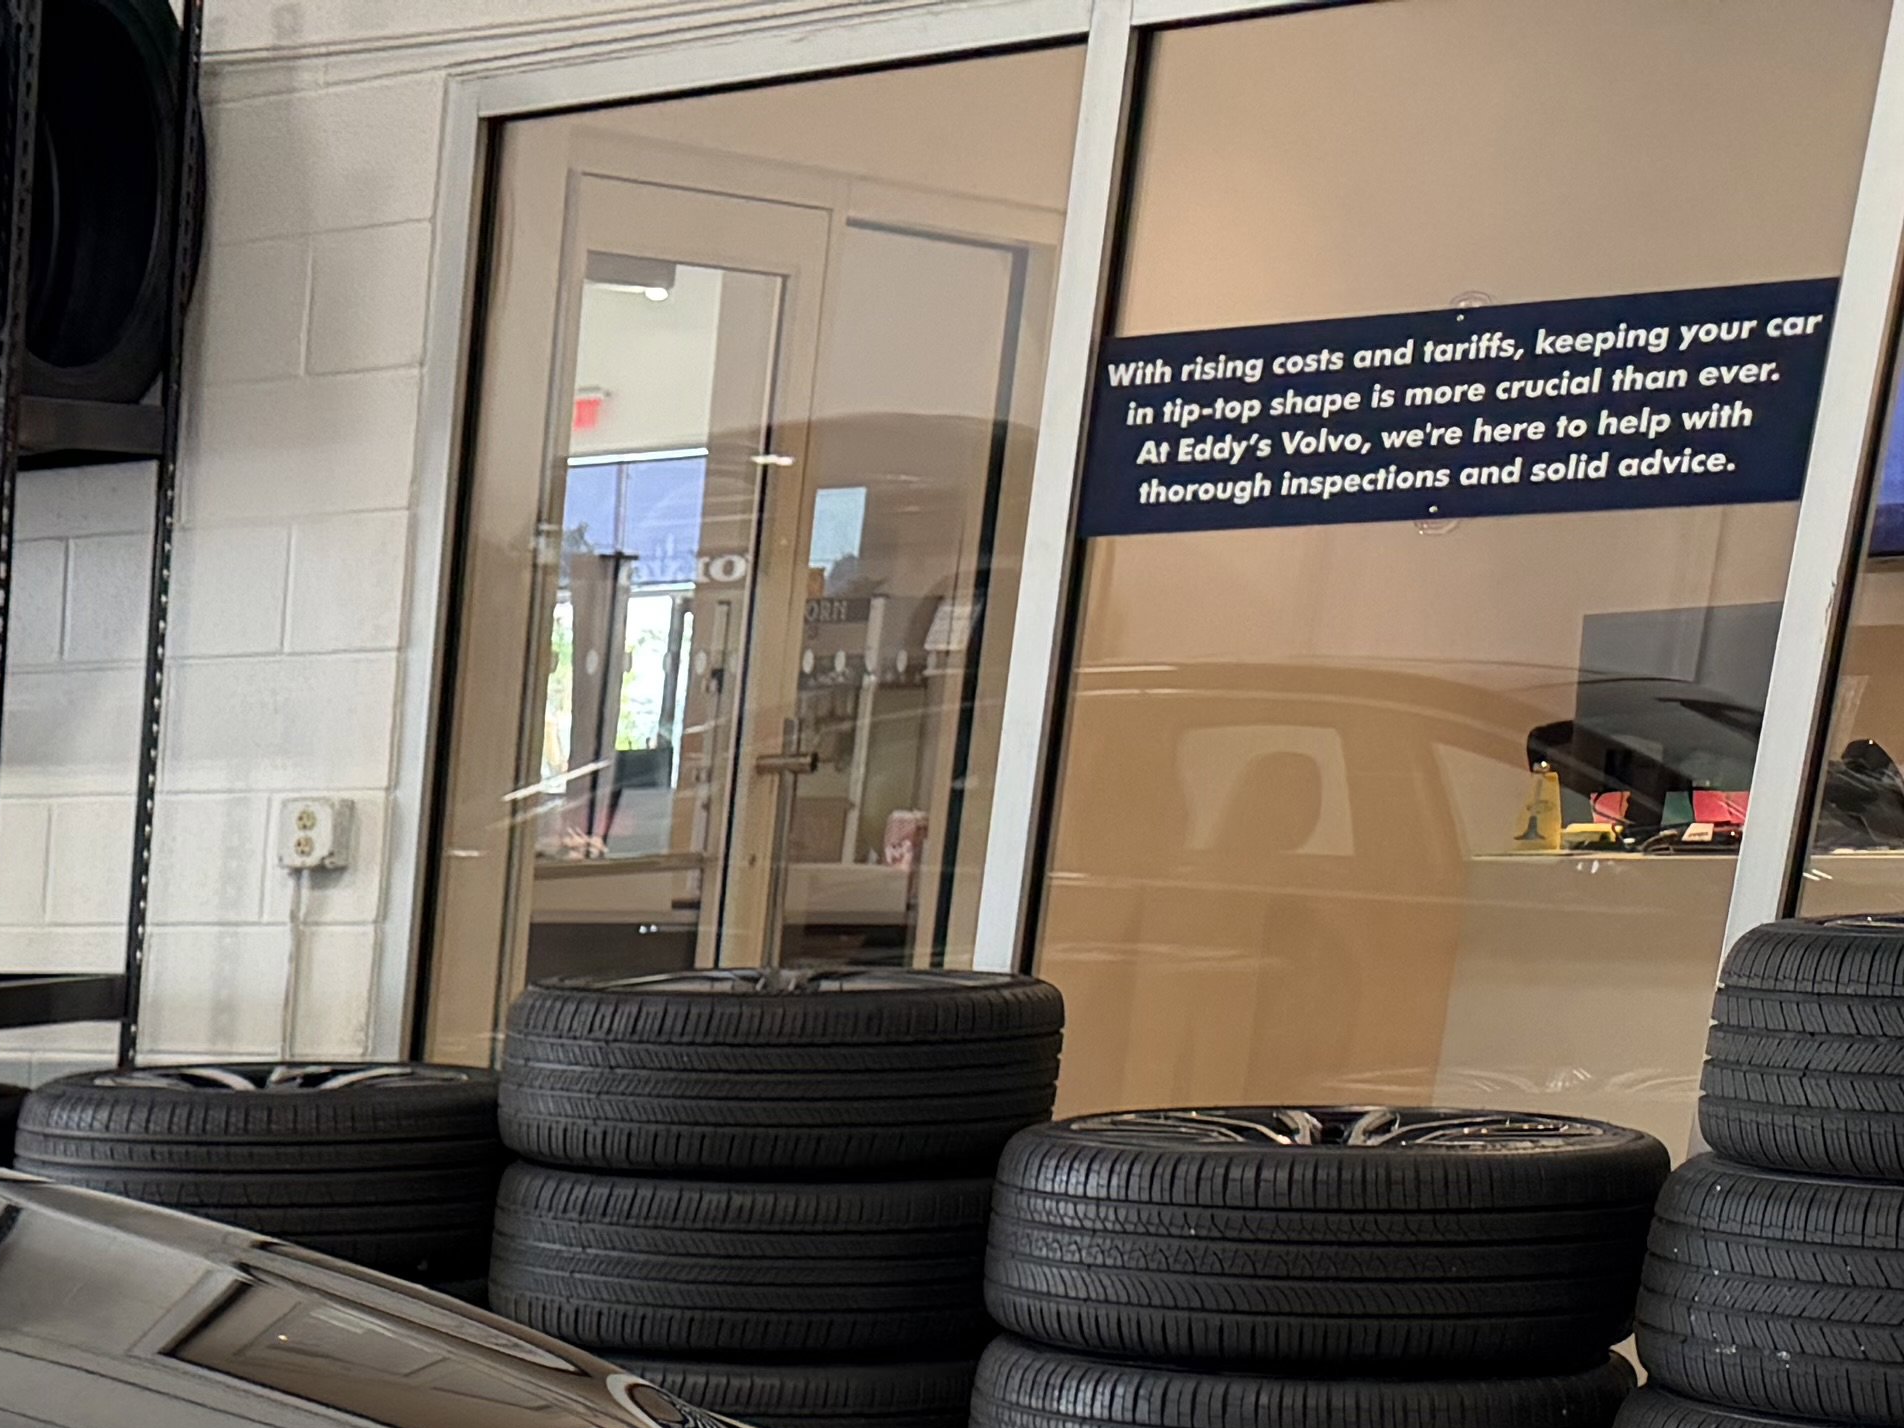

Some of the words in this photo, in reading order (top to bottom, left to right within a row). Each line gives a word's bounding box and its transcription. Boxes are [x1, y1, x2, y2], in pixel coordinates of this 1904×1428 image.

[1107, 358, 1173, 387] With
[1181, 354, 1265, 384] rising
[1272, 349, 1345, 375] costs
[1353, 338, 1415, 369] and
[1423, 331, 1525, 363] tariffs,
[1535, 322, 1670, 356] keeping
[1678, 319, 1758, 350] your
[1766, 313, 1824, 338] car
[1126, 401, 1155, 426] in
[1162, 397, 1263, 428] tip-top
[1269, 389, 1362, 418] shape
[1370, 383, 1396, 408] is
[1404, 381, 1486, 407] more
[1495, 367, 1602, 400] crucial
[1611, 364, 1689, 392] than
[1698, 360, 1780, 386] ever.
[1136, 439, 1171, 465] At
[1177, 433, 1273, 465] Eddy's
[1280, 427, 1372, 455] Volvo,
[1380, 422, 1464, 449] we're
[1472, 417, 1547, 444] here
[1555, 414, 1588, 439] to
[1597, 406, 1672, 439] help
[1681, 400, 1754, 431] with
[1138, 471, 1273, 505] thorough
[1280, 464, 1451, 499] inspections
[1459, 456, 1524, 486] and
[1529, 451, 1610, 482] solid
[1617, 447, 1737, 479] advice.
